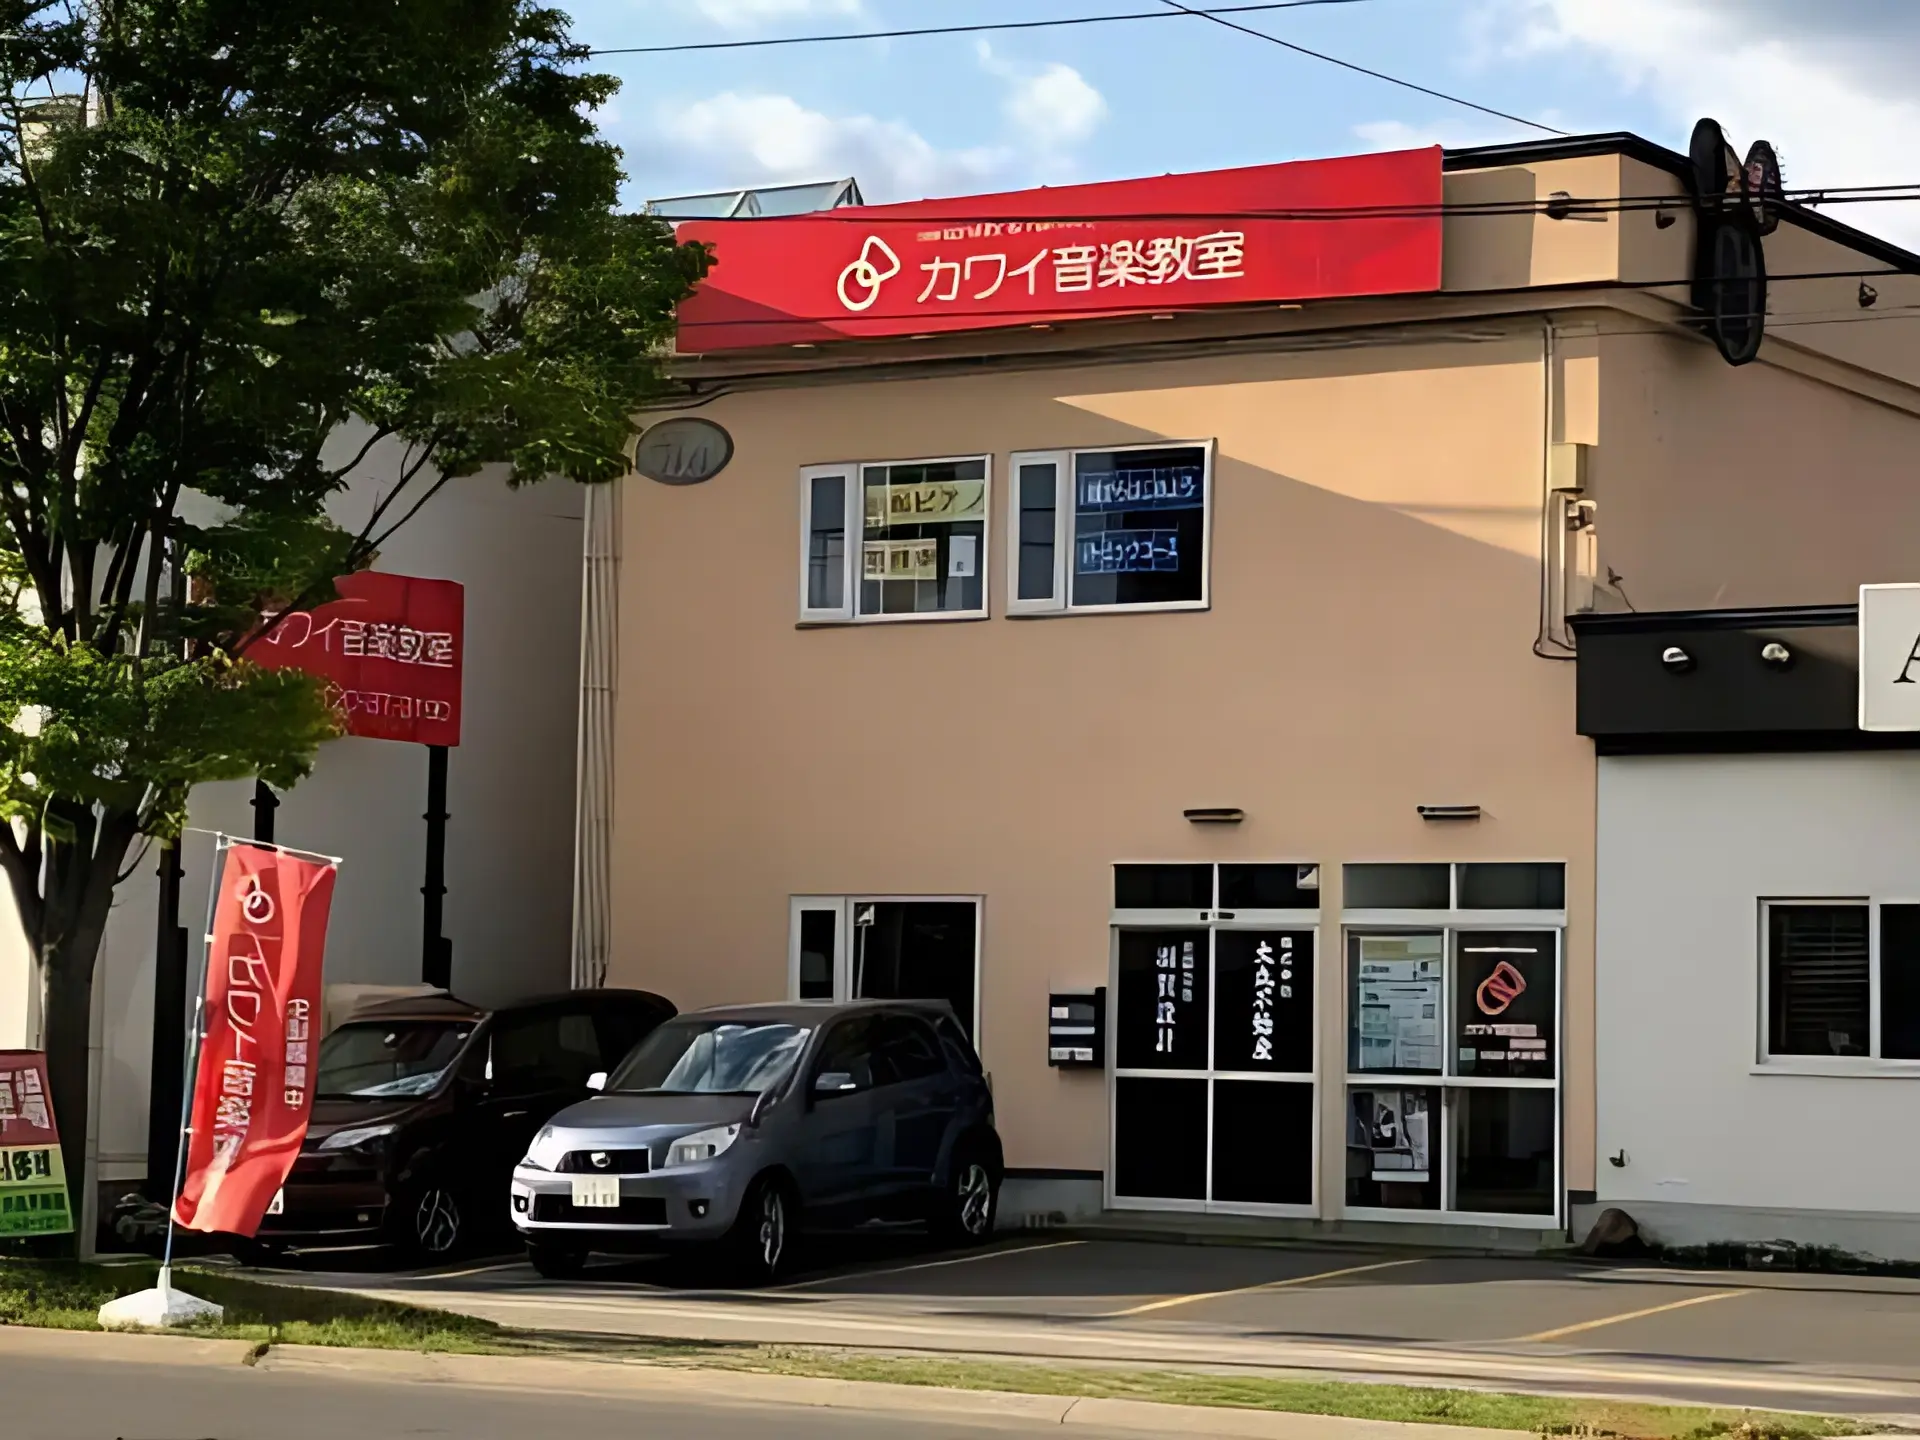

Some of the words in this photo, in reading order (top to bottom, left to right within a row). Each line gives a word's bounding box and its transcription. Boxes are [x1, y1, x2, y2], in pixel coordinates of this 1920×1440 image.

[917, 231, 1246, 304] カワイ音楽教室
